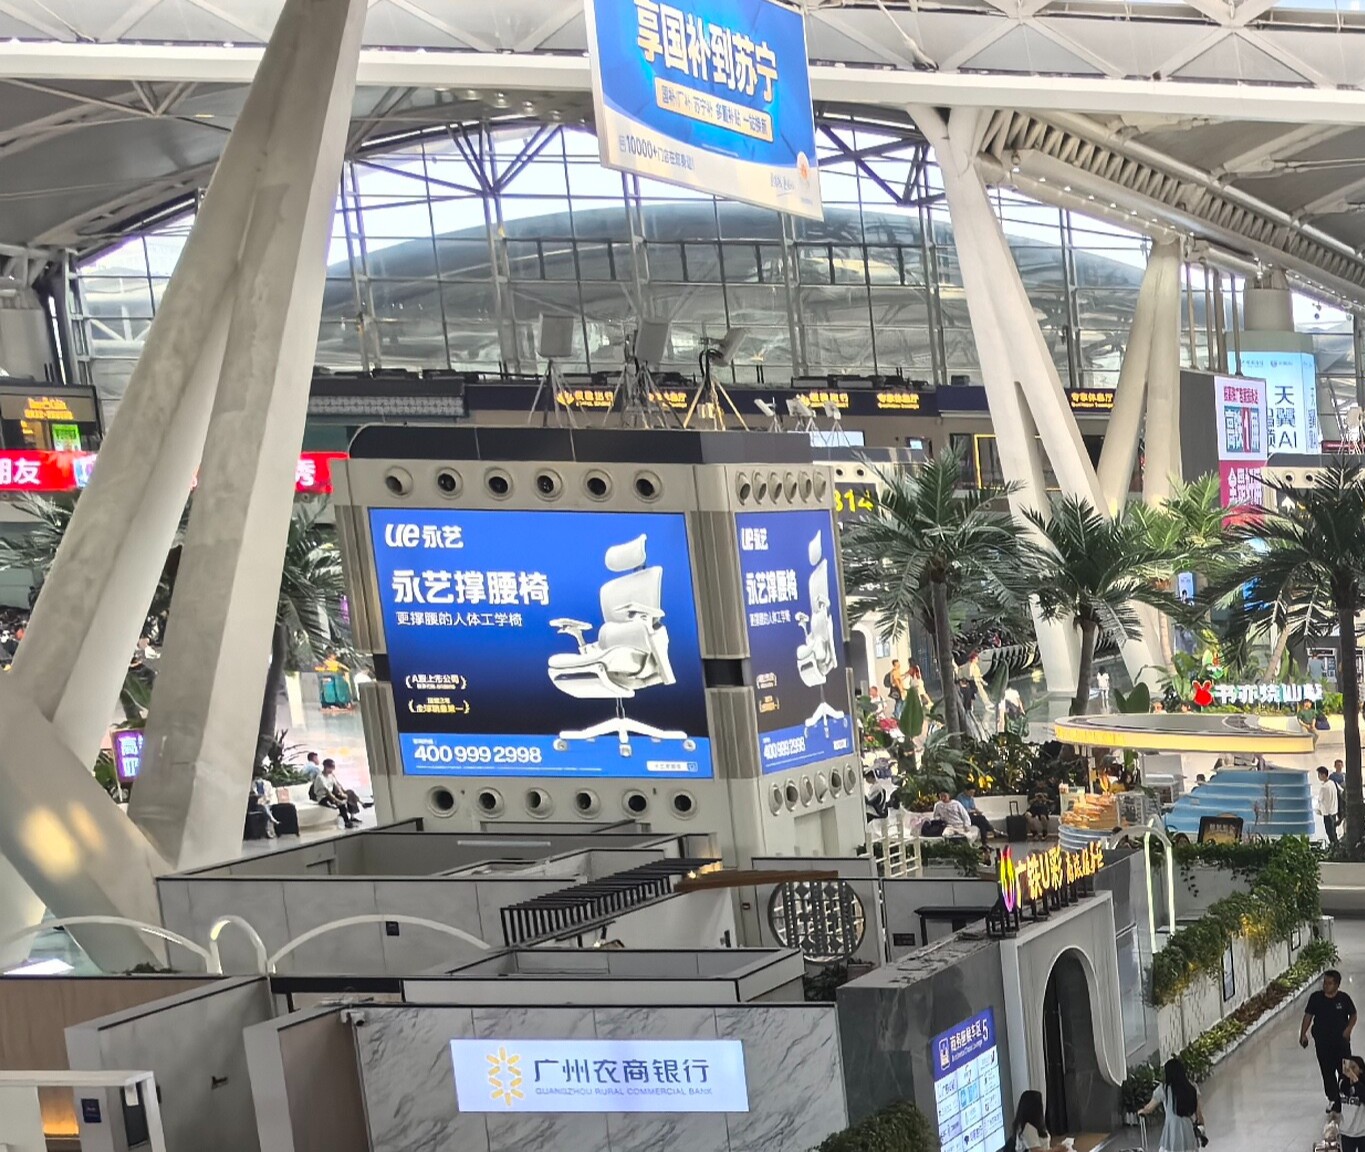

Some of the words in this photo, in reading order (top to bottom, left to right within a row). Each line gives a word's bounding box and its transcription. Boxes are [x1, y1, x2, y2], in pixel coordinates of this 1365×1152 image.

[635, 0, 778, 102] 享国补到苏宁
[422, 525, 464, 548] 永艺
[392, 570, 549, 606] 永艺撑腰椅
[745, 569, 798, 605] 永艺撑腰椅
[396, 611, 522, 627] 更撑腰的人体工学椅
[414, 745, 453, 763] 400
[454, 745, 491, 763] 999
[493, 745, 543, 764] 2998
[534, 1058, 710, 1083] 广州农商银行
[536, 1087, 593, 1096] GUANGZHOU
[595, 1087, 625, 1096] RURAL
[627, 1087, 687, 1096] COMMERCIAL
[689, 1087, 713, 1096] BANK
